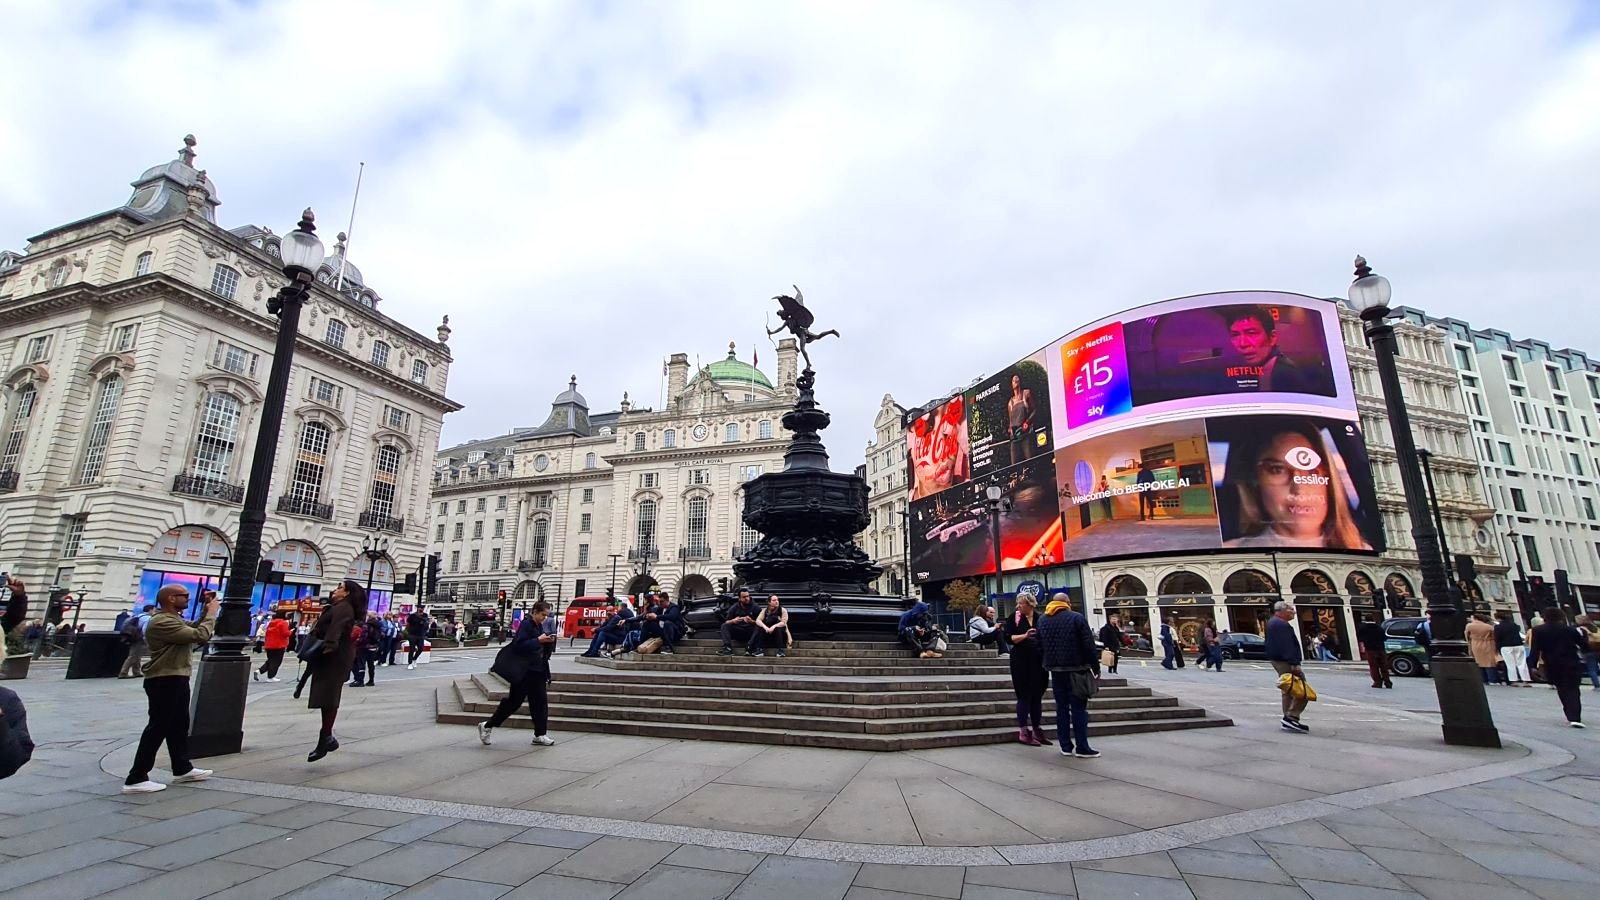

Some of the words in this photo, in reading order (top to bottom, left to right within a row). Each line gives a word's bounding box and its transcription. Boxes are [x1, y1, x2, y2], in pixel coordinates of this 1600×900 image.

[1066, 348, 1079, 358] Sky
[1085, 334, 1114, 349] Netflix
[1073, 354, 1113, 395] £15
[1226, 366, 1265, 377] NETFLIX
[975, 382, 1001, 402] PARKSIDE
[1087, 404, 1105, 417] sky
[1293, 473, 1330, 486] essilor
[1071, 490, 1111, 505] Welcome
[1113, 487, 1124, 496] to
[1125, 479, 1176, 495] BESPOKE
[1178, 477, 1190, 488] AI
